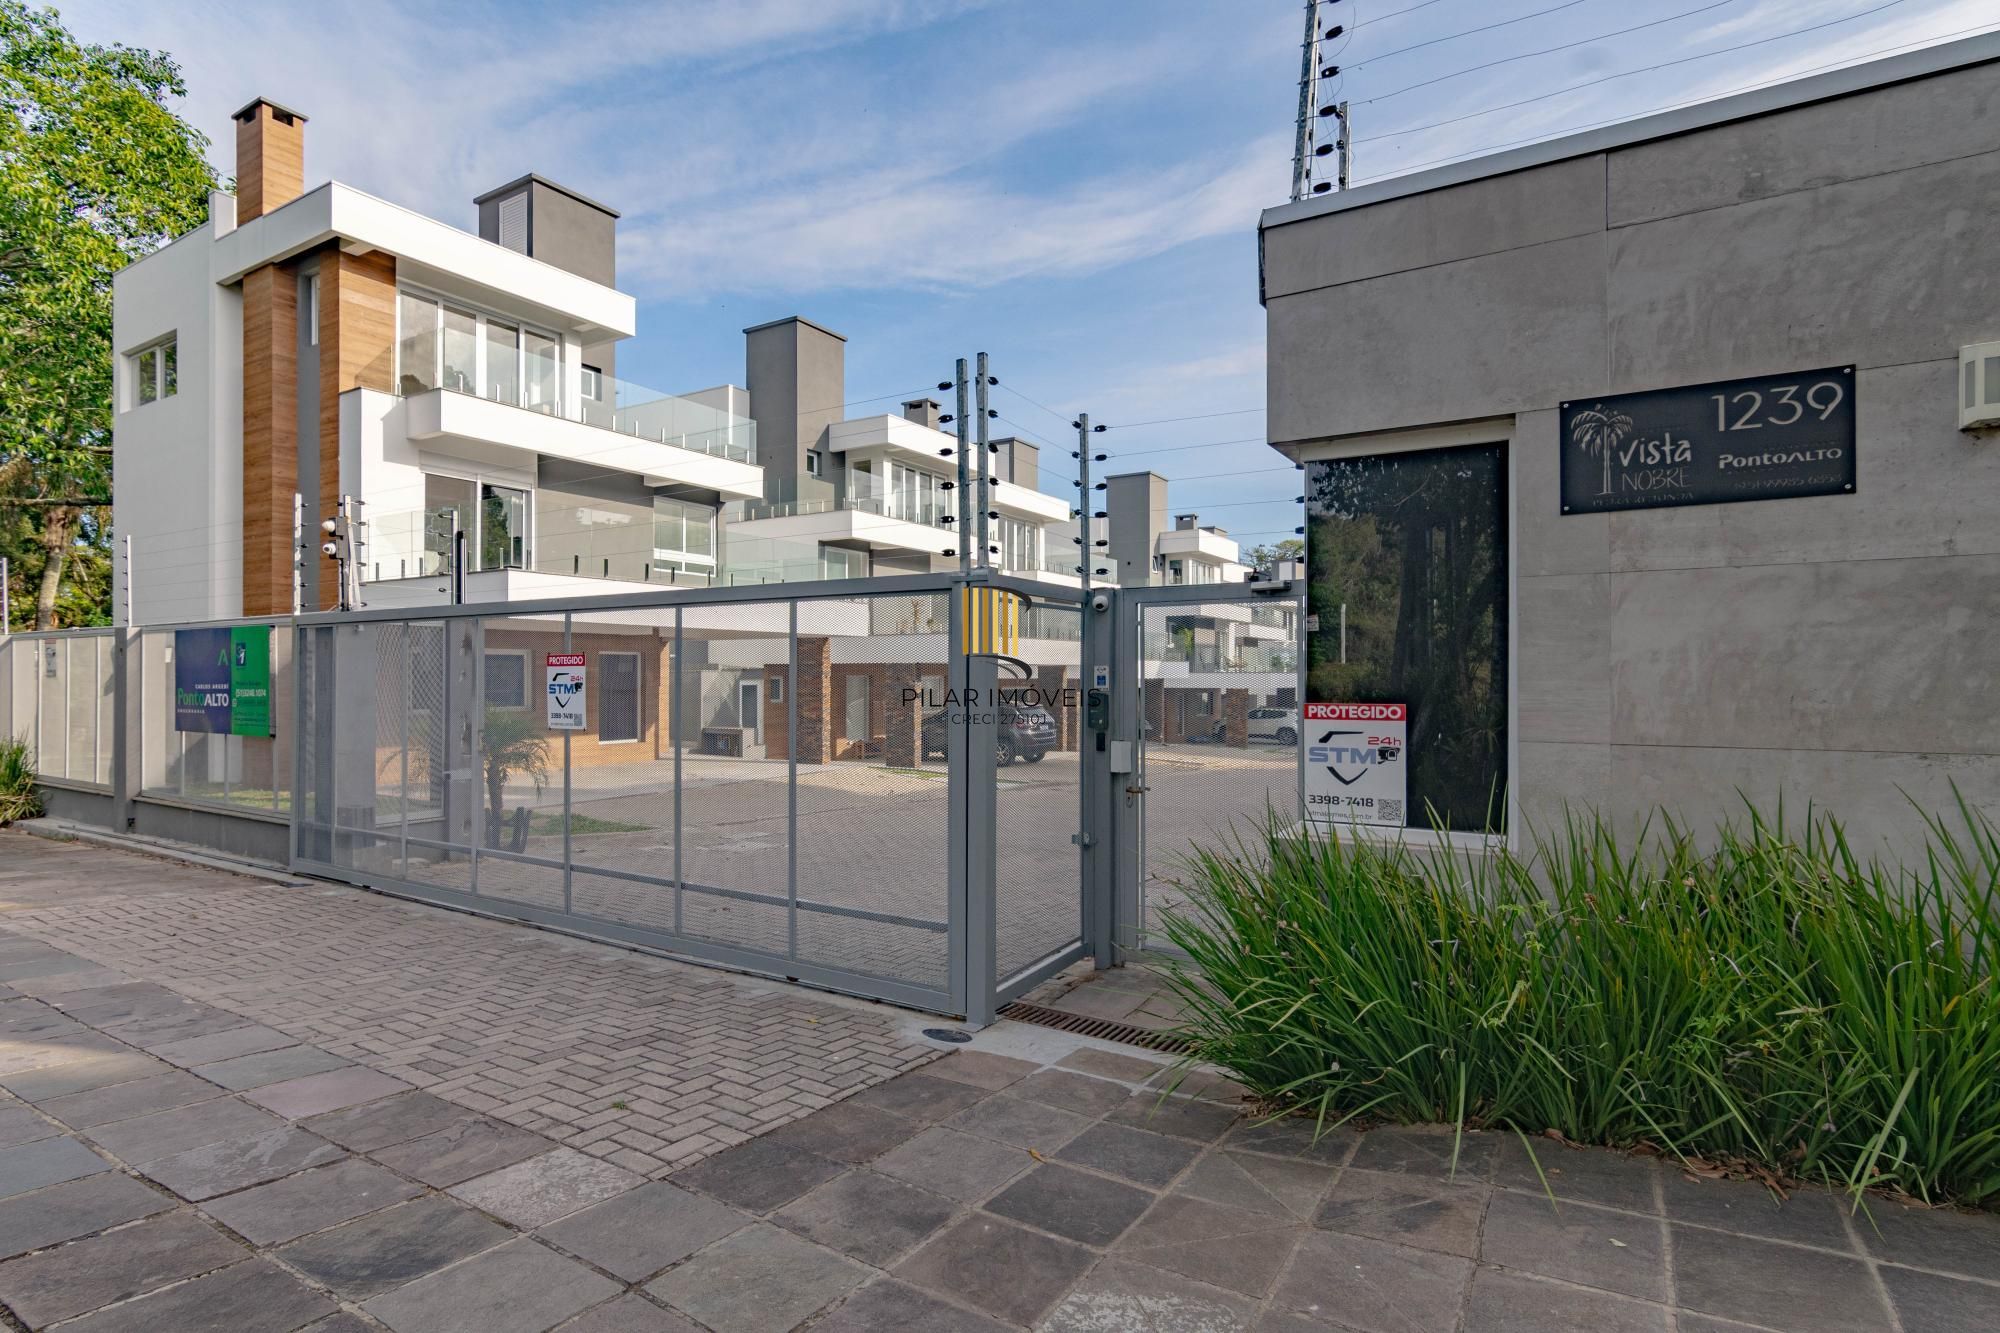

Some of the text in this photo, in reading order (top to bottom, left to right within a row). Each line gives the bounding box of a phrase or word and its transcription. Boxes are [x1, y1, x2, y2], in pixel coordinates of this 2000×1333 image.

[1711, 381, 1844, 432] 1239
[1621, 467, 1692, 492] NOBRE
[548, 656, 584, 665] PROTEGIDO
[549, 684, 574, 695] STM
[177, 688, 229, 707] PontoALTO
[1308, 705, 1402, 719] PROTEGIDO
[1367, 736, 1401, 746] 24h
[1308, 746, 1377, 764] STM
[1308, 794, 1374, 807] 3398-7418
